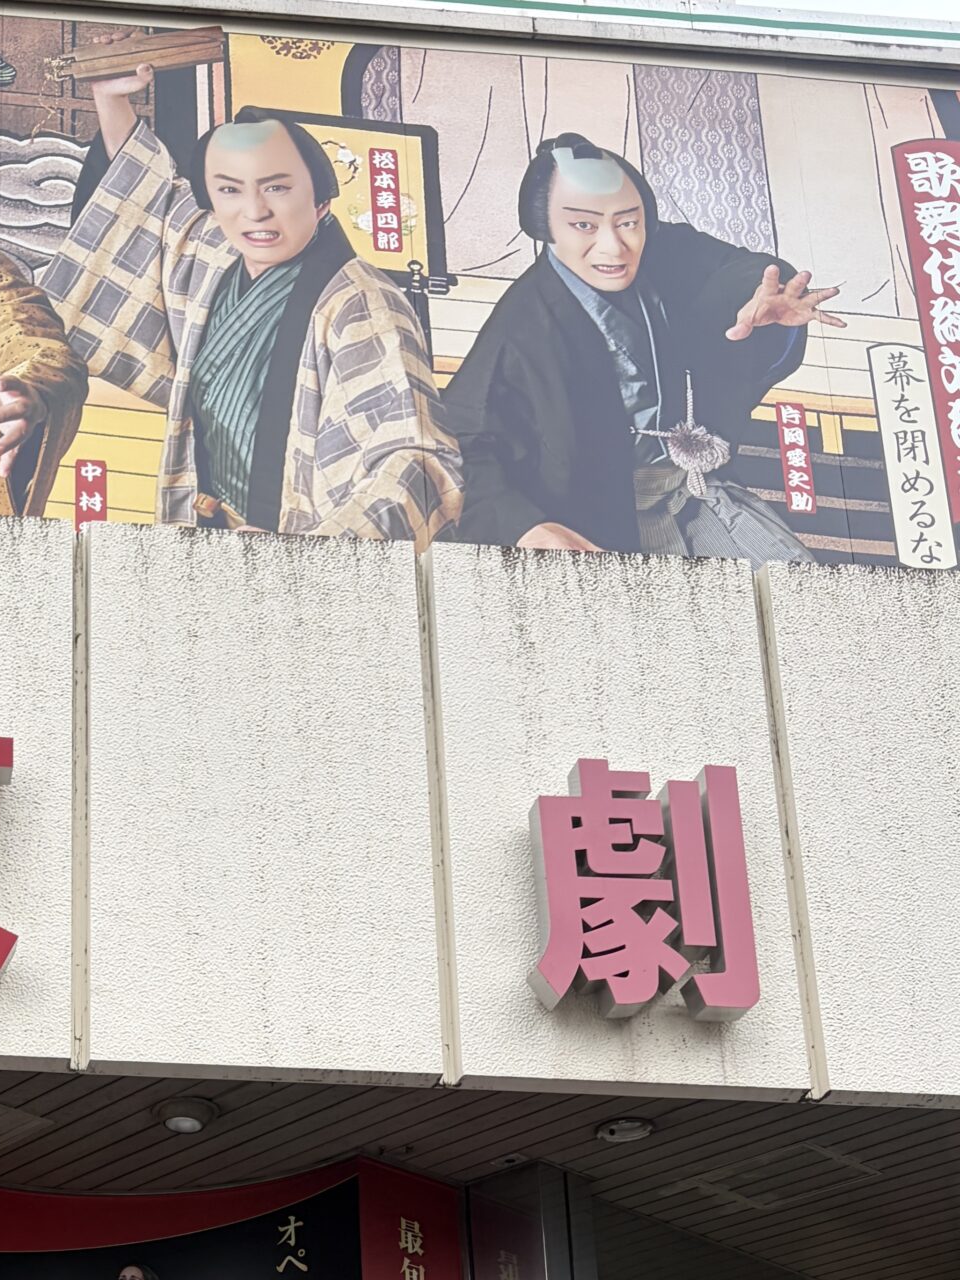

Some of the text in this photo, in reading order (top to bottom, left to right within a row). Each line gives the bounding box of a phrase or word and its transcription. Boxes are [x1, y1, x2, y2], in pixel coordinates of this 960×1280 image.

[371, 151, 401, 250] 松本幸四郎
[79, 462, 103, 524] 中村
[883, 352, 943, 564] 幕を閉めるな
